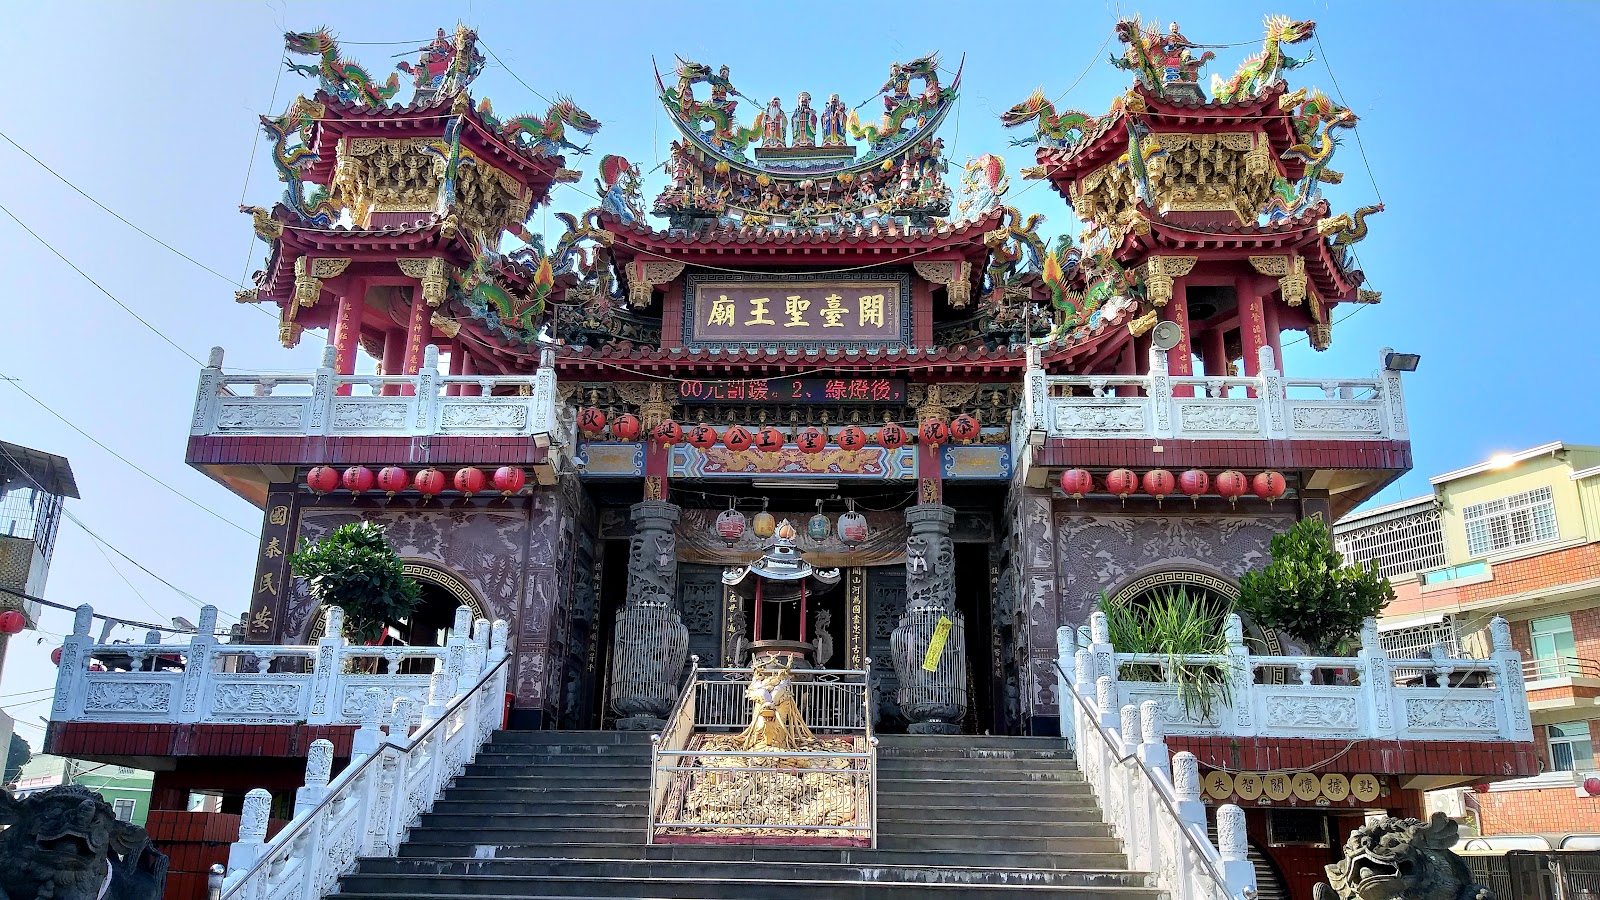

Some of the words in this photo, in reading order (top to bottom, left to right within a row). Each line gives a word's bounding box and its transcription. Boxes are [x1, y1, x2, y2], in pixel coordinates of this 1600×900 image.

[707, 294, 884, 328] 開臺聖王廟
[252, 505, 288, 629] 國泰民安
[1214, 777, 1373, 794] 失智關懷據點
